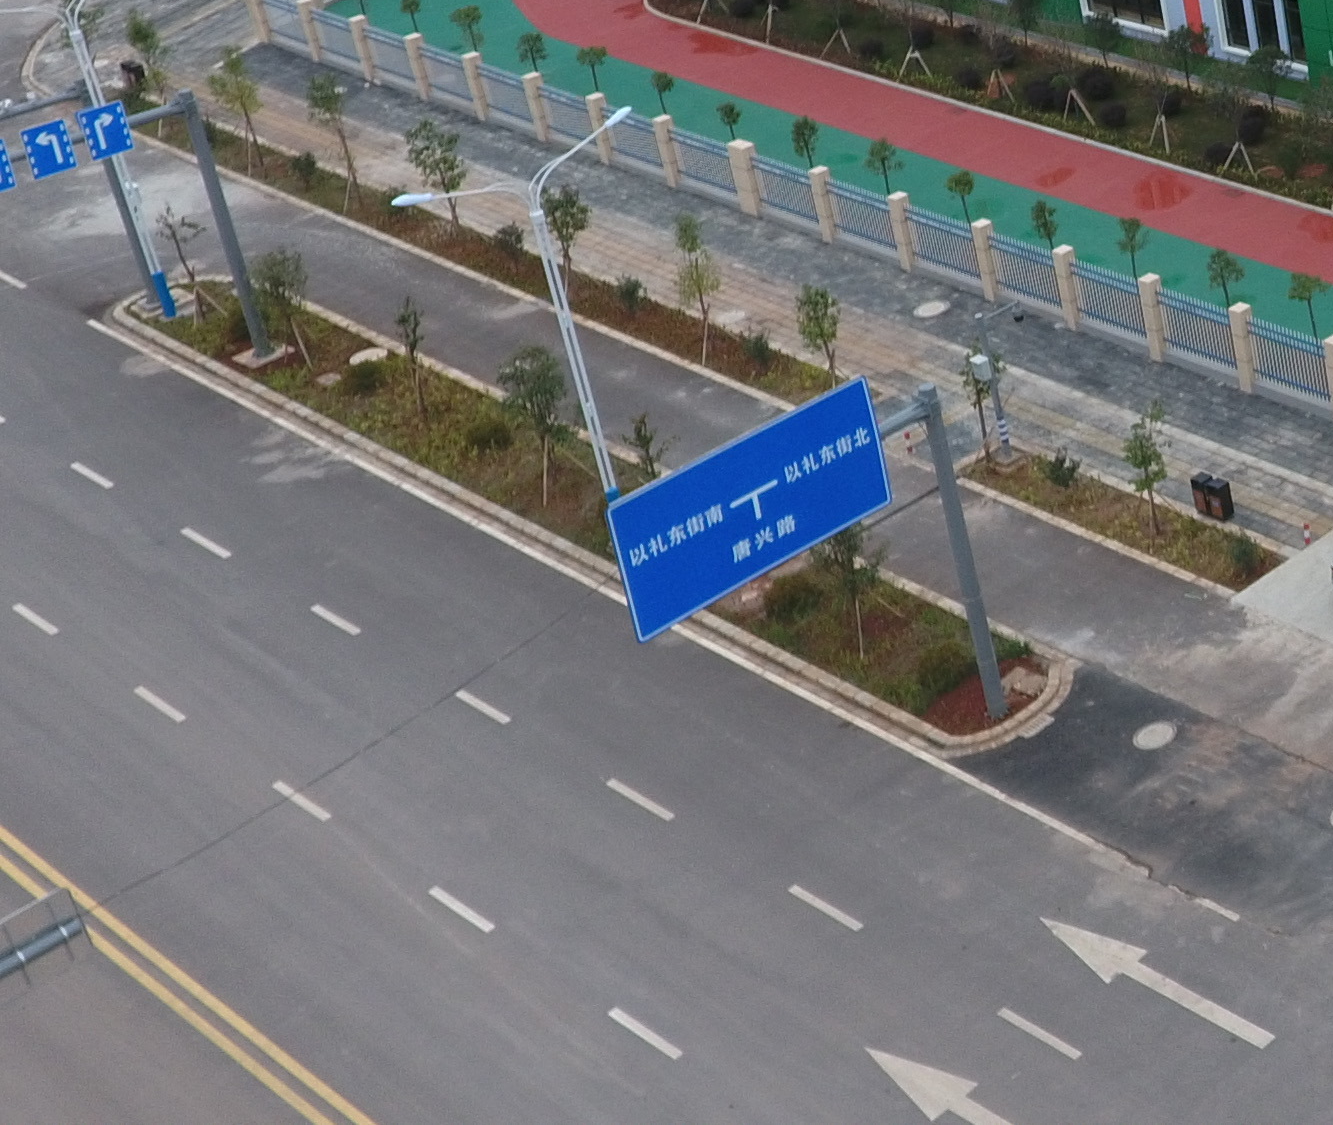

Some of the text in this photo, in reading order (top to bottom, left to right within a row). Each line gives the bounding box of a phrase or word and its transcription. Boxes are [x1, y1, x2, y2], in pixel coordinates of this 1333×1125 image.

[784, 427, 871, 484] 以礼东街北
[628, 503, 724, 568] 以礼东街南
